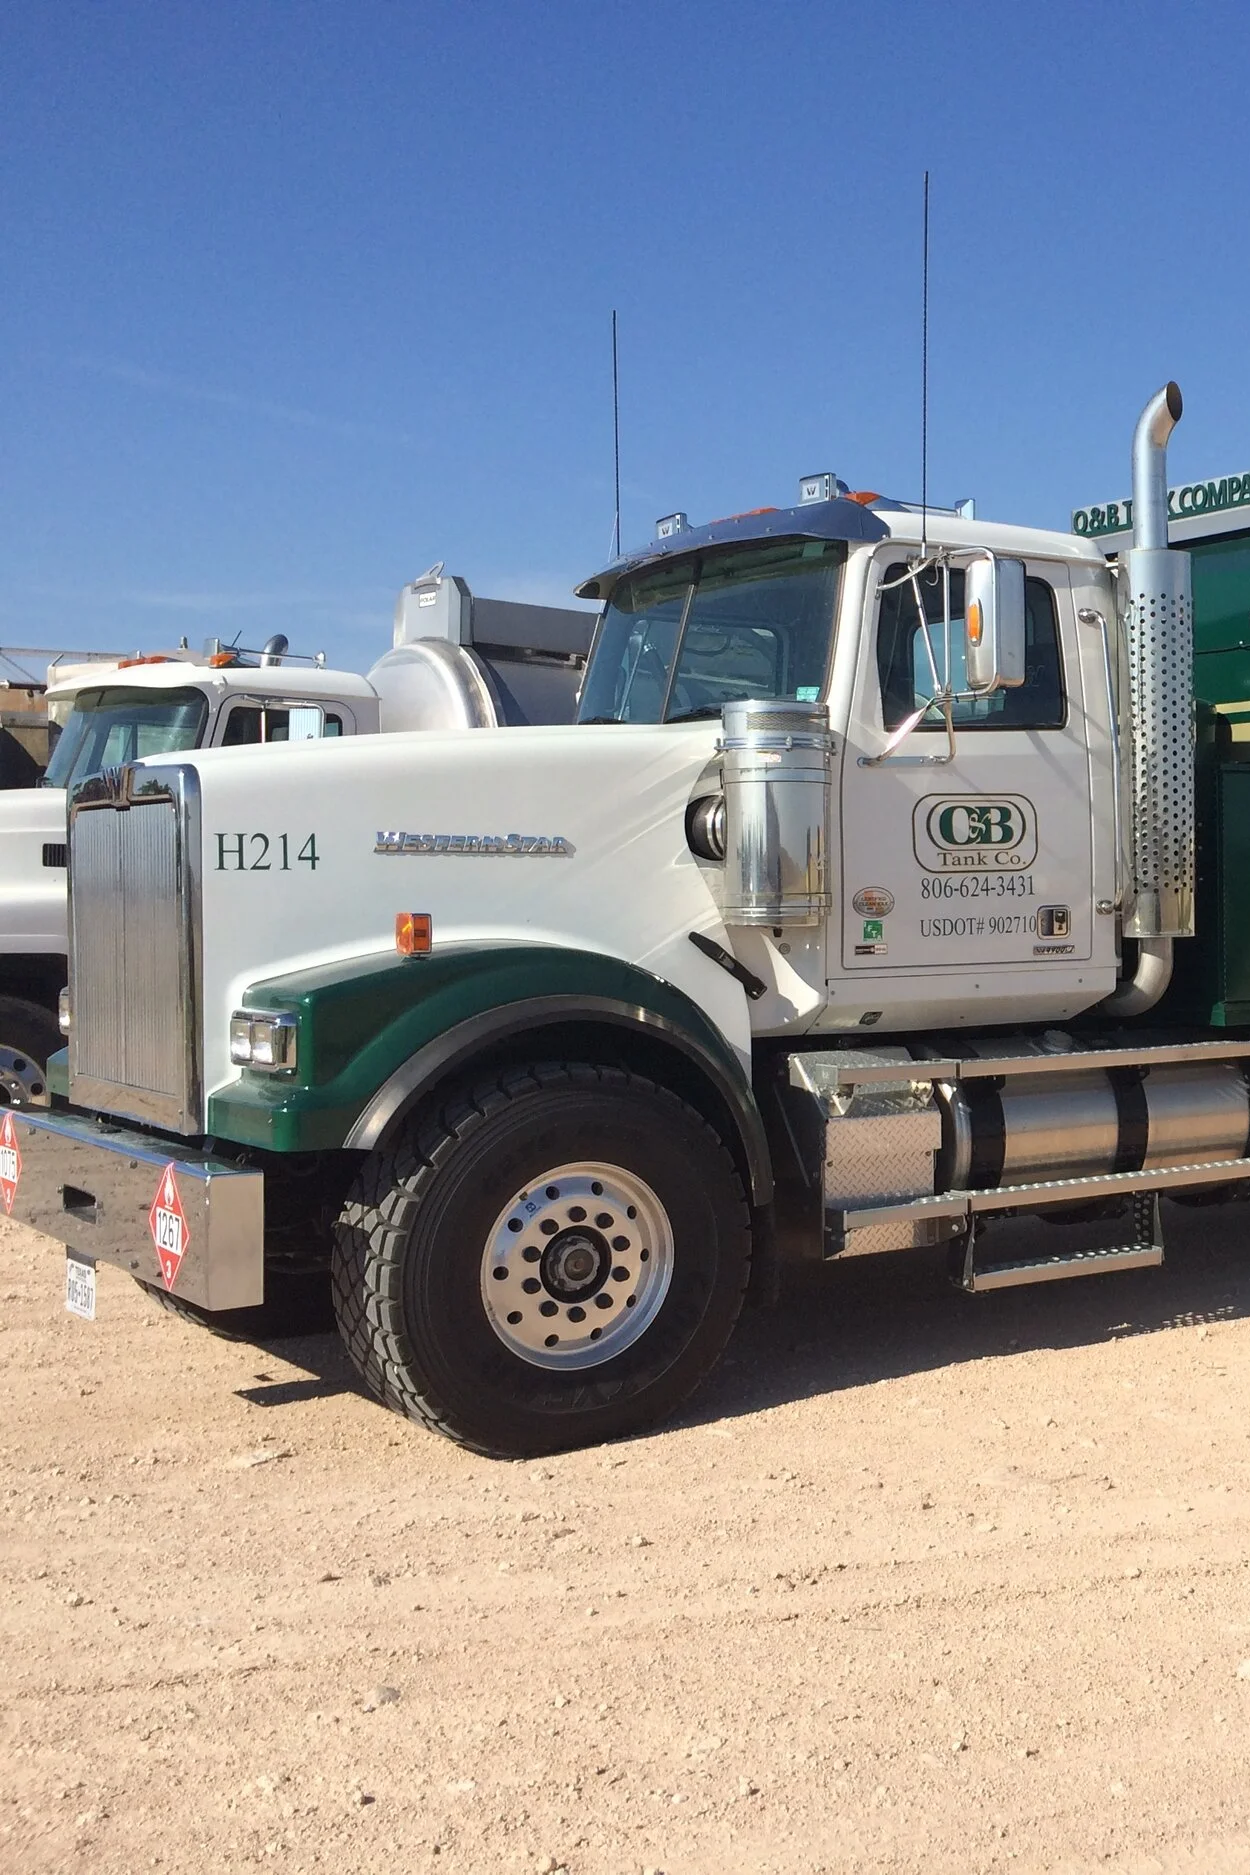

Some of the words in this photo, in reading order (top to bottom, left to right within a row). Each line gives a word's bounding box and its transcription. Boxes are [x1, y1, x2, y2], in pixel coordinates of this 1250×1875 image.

[939, 805, 1014, 846] O&B
[213, 832, 320, 871] H214
[937, 852, 988, 866] Tank
[994, 851, 1026, 866] Co.
[921, 875, 1035, 899] 806-624-3431
[920, 917, 984, 938] USDOT#
[989, 916, 1037, 936] 902710
[157, 1208, 181, 1248] 1267
[165, 1260, 172, 1279] 3
